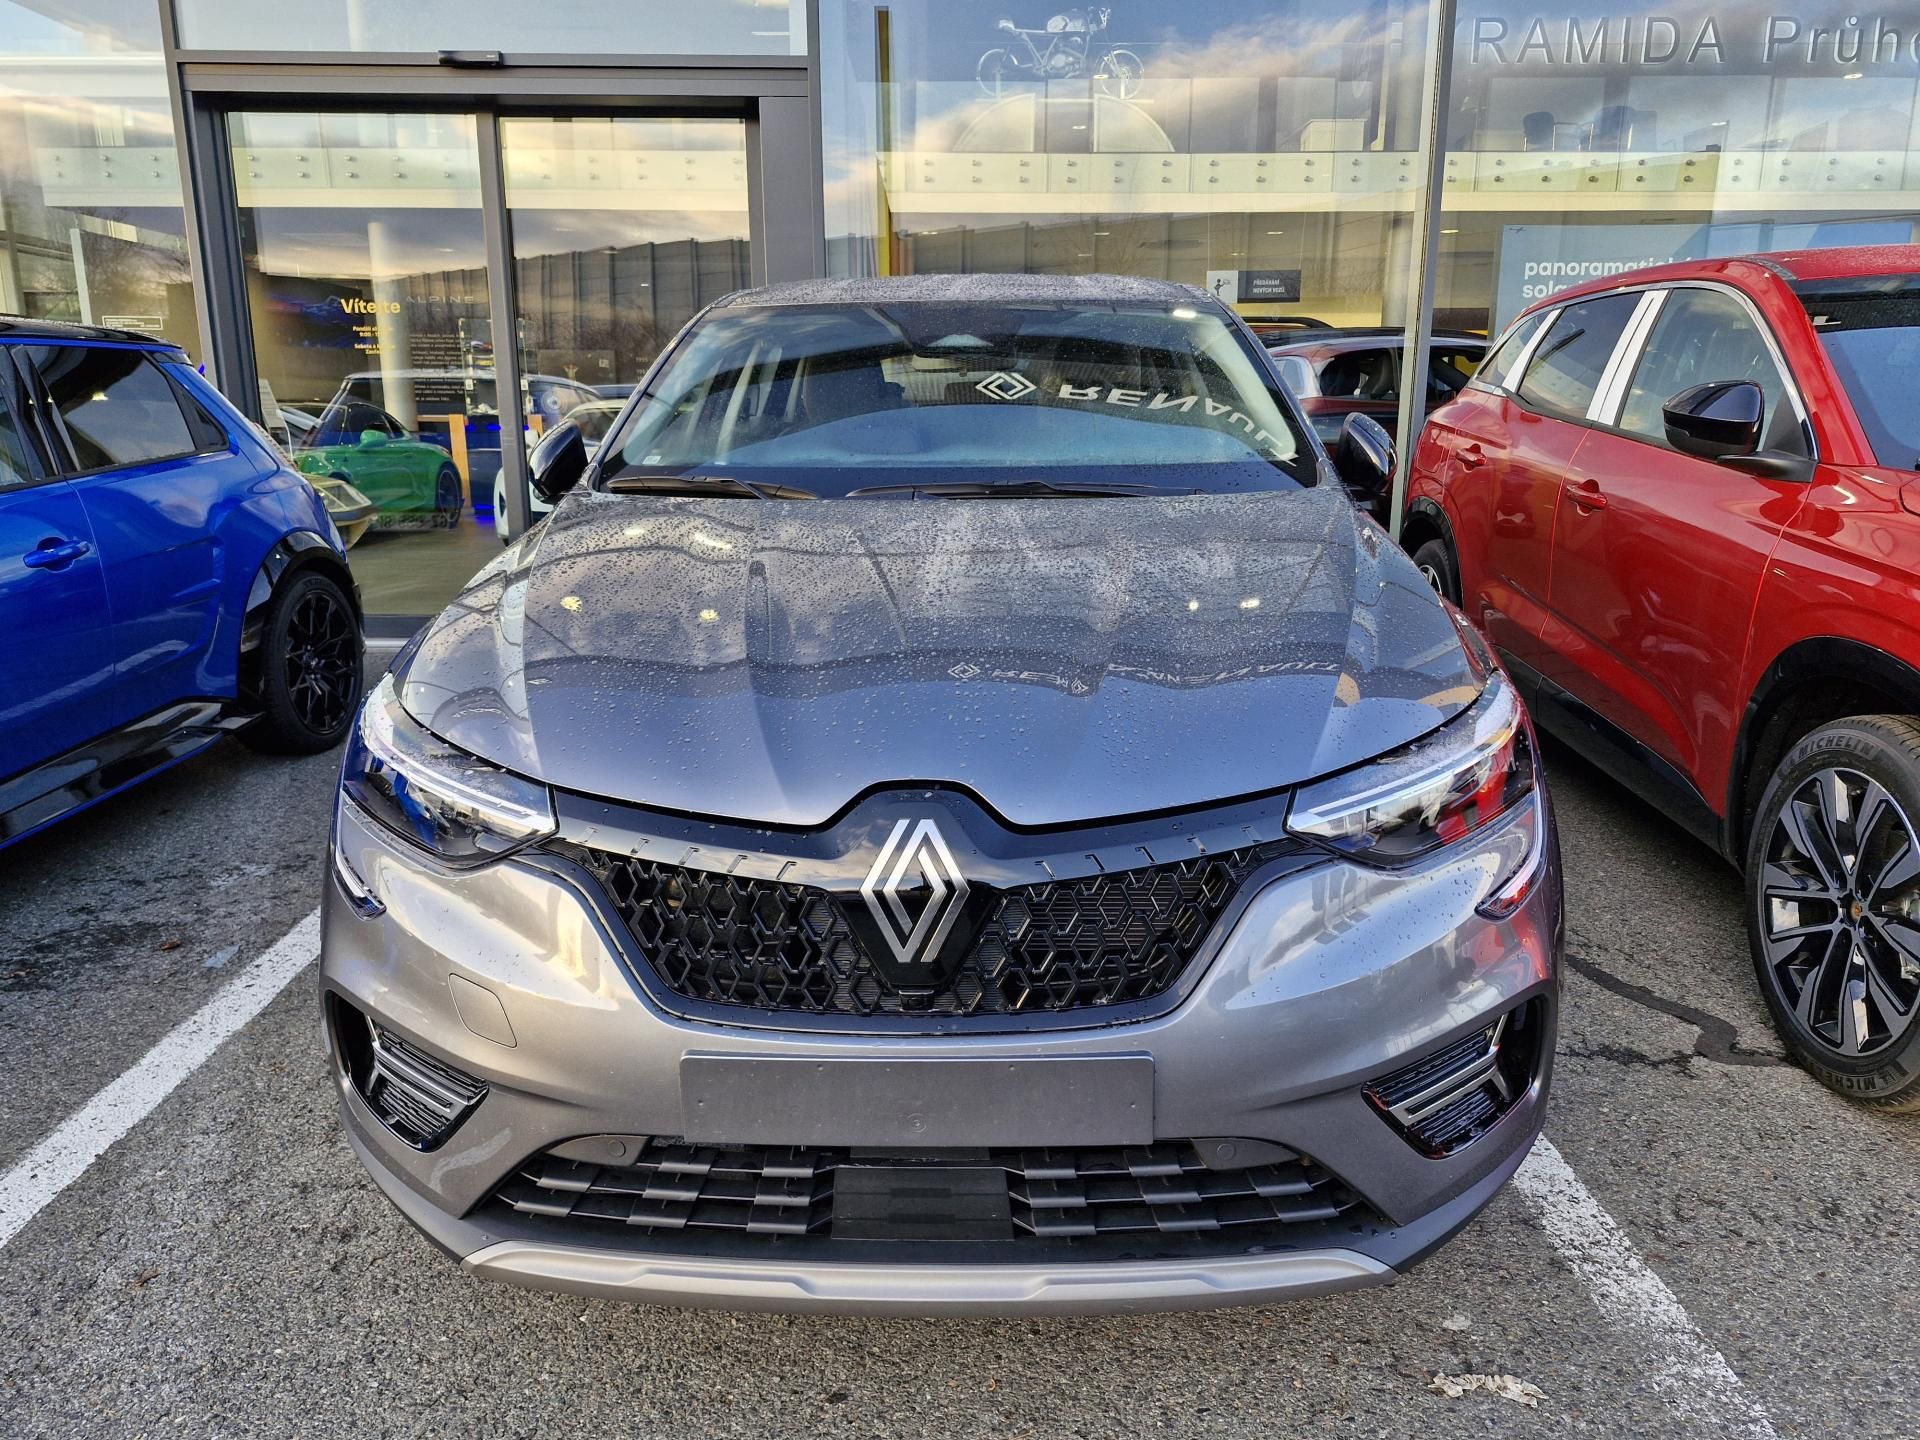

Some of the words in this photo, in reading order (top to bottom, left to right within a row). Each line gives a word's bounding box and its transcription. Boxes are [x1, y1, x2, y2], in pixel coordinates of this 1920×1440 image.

[1456, 16, 1727, 65] RAMIDA
[1524, 256, 1693, 280] panoramati
[406, 296, 474, 304] ALPINE
[1799, 735, 1873, 758] MICHELIN
